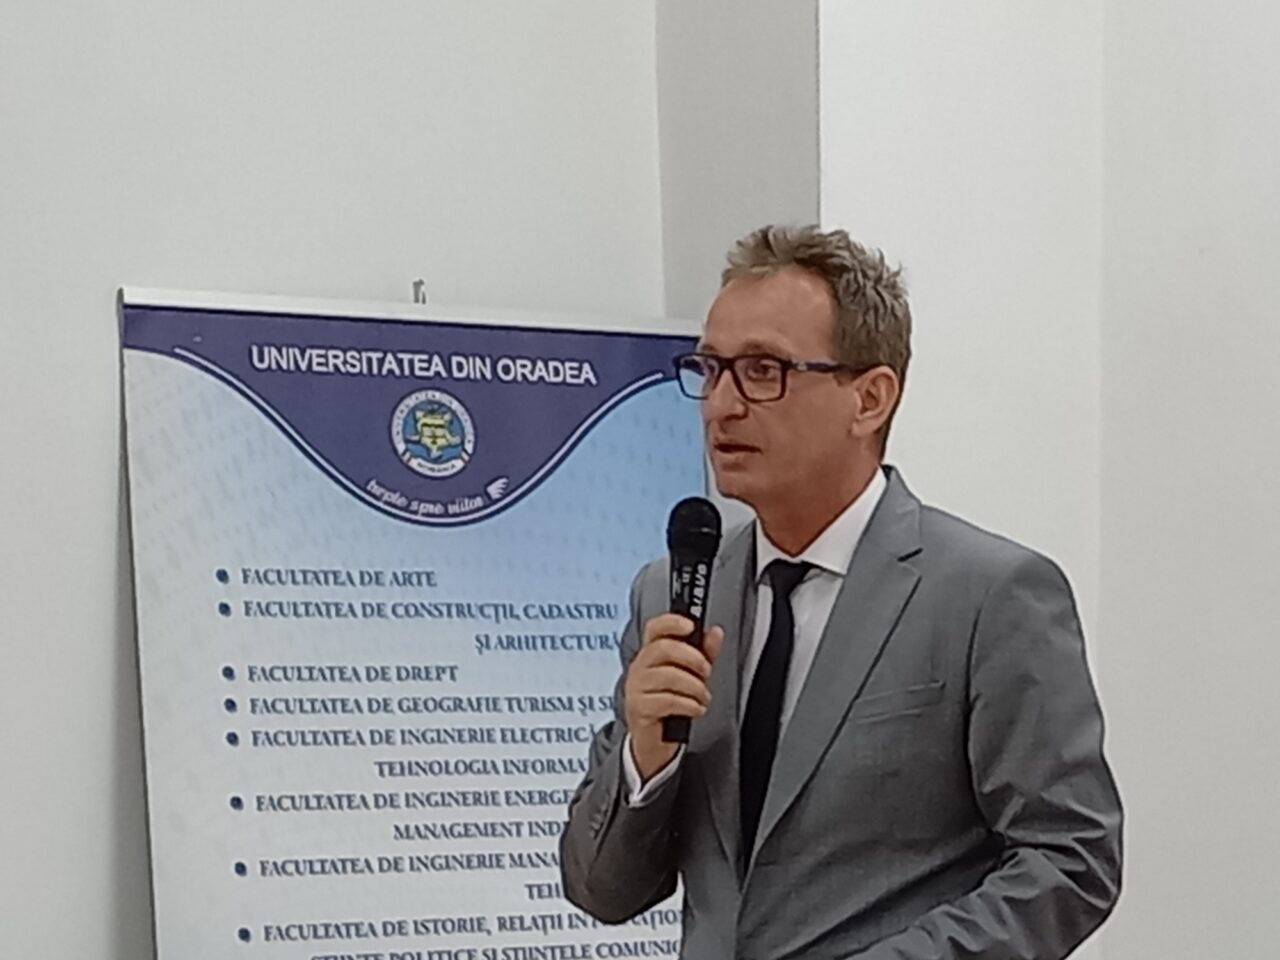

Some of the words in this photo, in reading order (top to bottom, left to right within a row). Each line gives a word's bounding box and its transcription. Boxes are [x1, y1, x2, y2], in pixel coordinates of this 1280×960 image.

[252, 345, 447, 378] UNIVERSITATEA
[451, 354, 492, 380] DIN
[497, 358, 598, 386] ORADEA
[241, 568, 355, 587] FACULTATEA
[358, 570, 386, 587] DE
[389, 571, 437, 587] ARTE
[243, 601, 357, 619] FACULTATEA
[361, 602, 389, 619] DE
[522, 603, 618, 620] CADASTRU
[247, 665, 362, 683] FACULTATEA
[365, 666, 392, 683] DE
[395, 665, 459, 683] DREPT
[249, 697, 364, 715] FACULTATEA
[366, 697, 393, 714] DE
[398, 696, 501, 714] GEOGRAFIE
[251, 729, 367, 748] FACULTATEA
[369, 729, 397, 747] DE
[399, 727, 497, 746] INGINERIE
[374, 759, 499, 778] TEHNOLOGIA
[502, 757, 586, 776] INFORMA
[256, 793, 371, 812] FACULTATEA
[373, 792, 401, 810] DE
[404, 790, 502, 809] INGINERIE
[504, 789, 576, 807] ENERGE
[393, 821, 524, 841] MANAGEMENT
[527, 820, 566, 838] IND
[260, 857, 374, 877] FACULTATEA
[377, 857, 405, 875] DE
[409, 854, 505, 873] INGINERIE
[263, 920, 379, 942] FACULTATEA
[381, 919, 409, 937] DE
